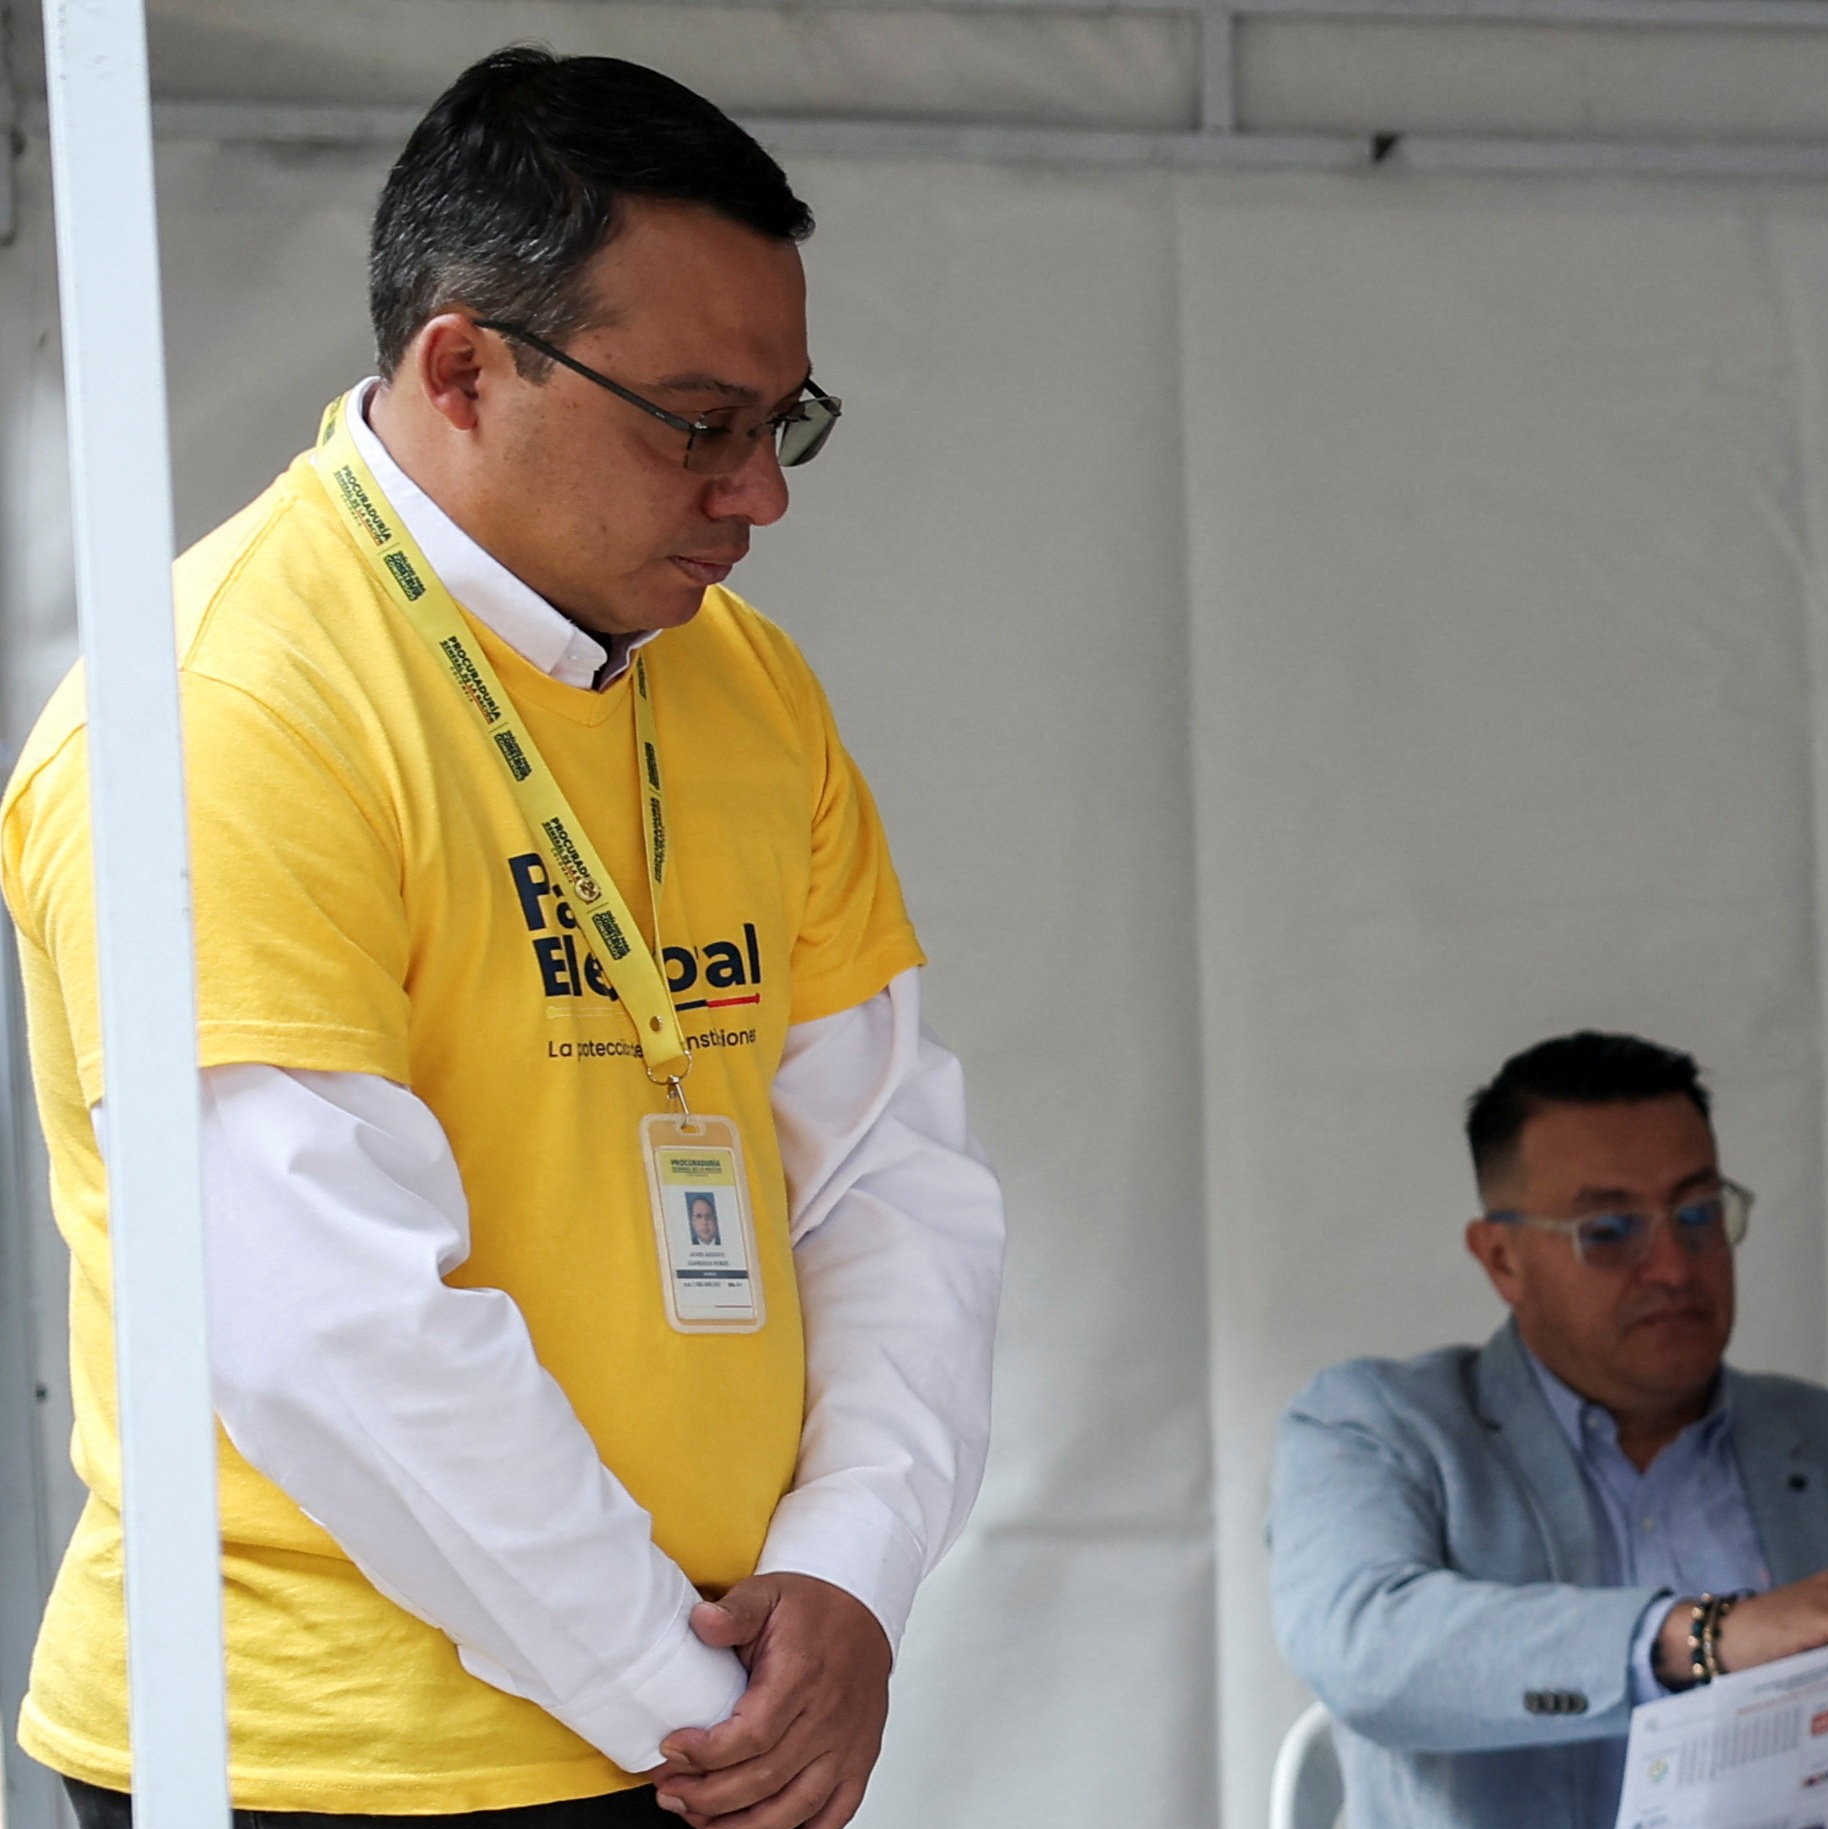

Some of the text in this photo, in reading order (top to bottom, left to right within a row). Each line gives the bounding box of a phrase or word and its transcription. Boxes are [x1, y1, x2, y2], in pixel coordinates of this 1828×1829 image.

[340, 464, 393, 541] PROCURADURÍA
[447, 634, 503, 720] PROCURADURÍA
[508, 853, 583, 931] Pa
[532, 923, 762, 1002] Eleoal
[548, 1040, 572, 1058] La
